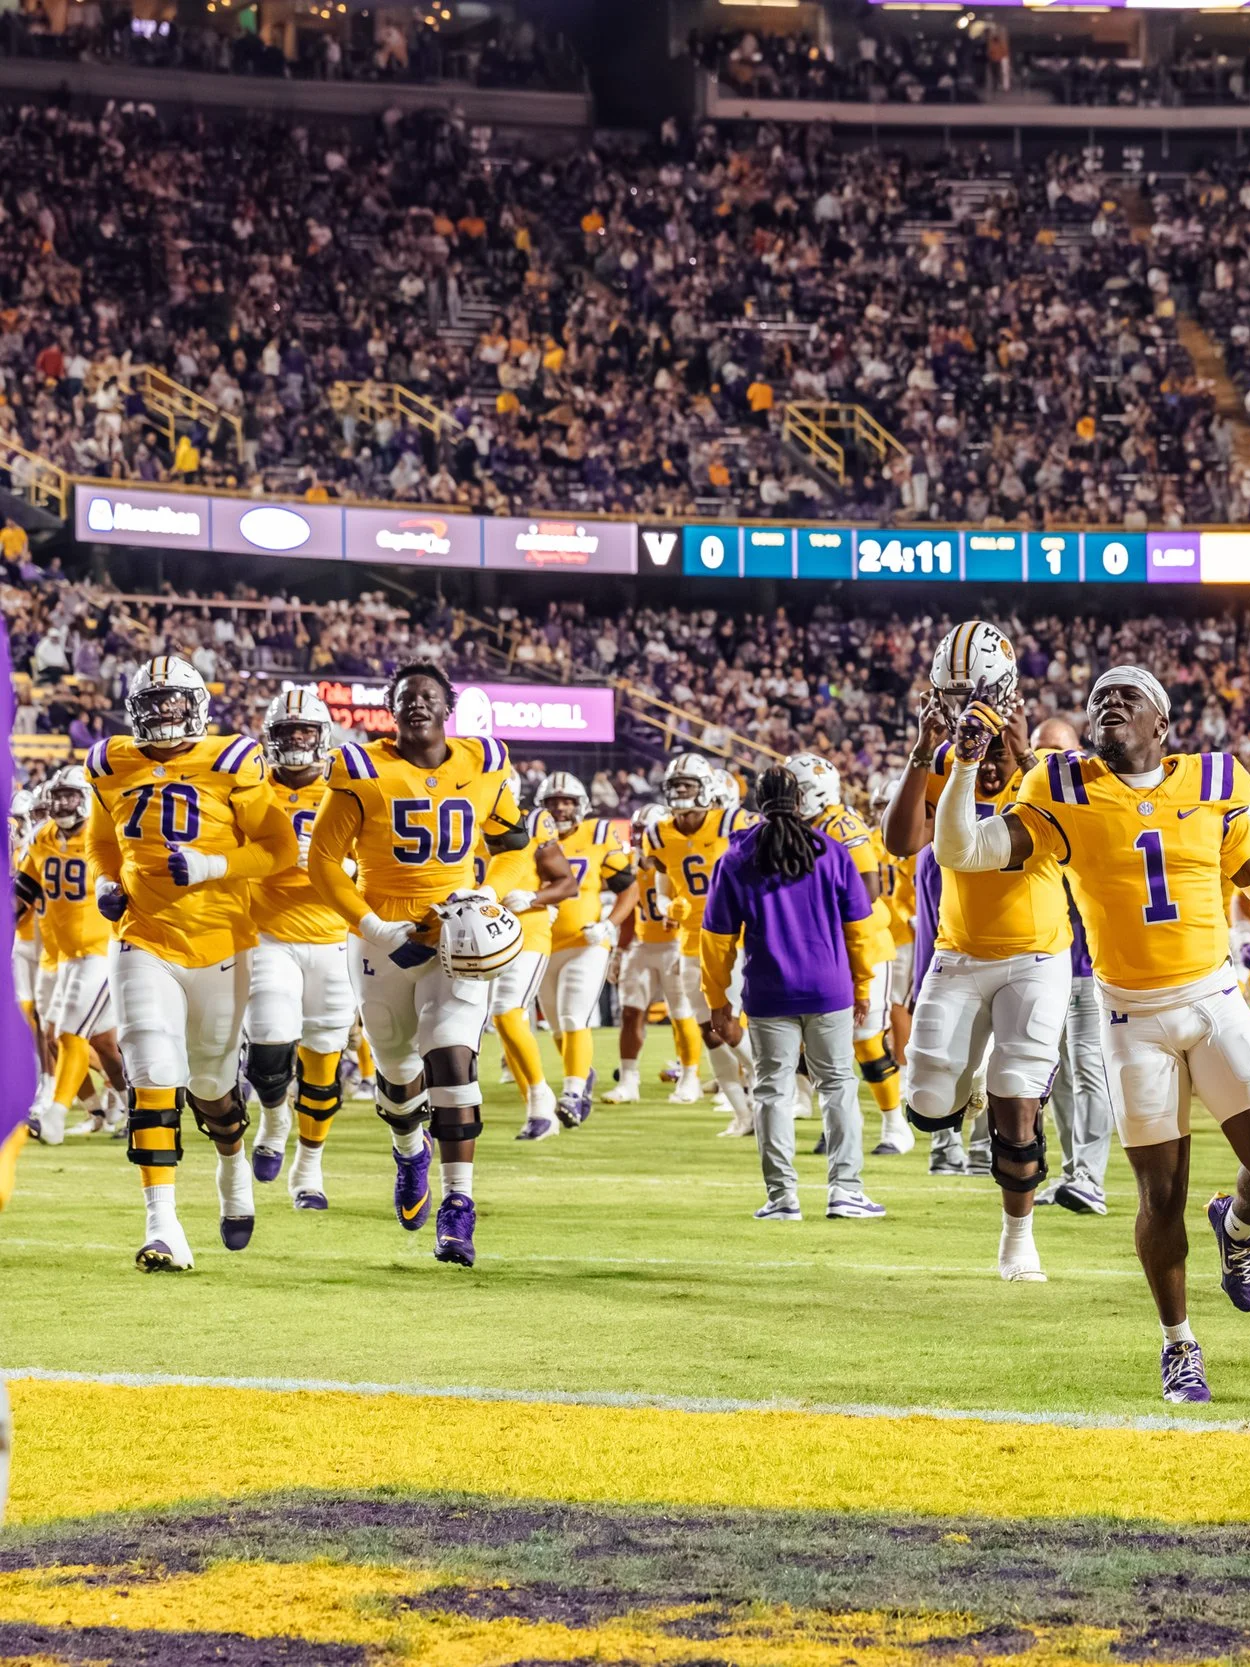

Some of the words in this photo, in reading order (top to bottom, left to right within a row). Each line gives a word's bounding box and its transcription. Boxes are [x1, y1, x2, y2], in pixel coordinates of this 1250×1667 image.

[642, 531, 678, 566] V
[700, 535, 725, 569] 0
[858, 539, 951, 573] 24:11
[1046, 548, 1061, 574] 1
[1102, 542, 1129, 575] 0
[121, 782, 202, 843] 70
[391, 797, 476, 866] 50
[44, 855, 87, 901] 99
[1132, 828, 1181, 926] 1
